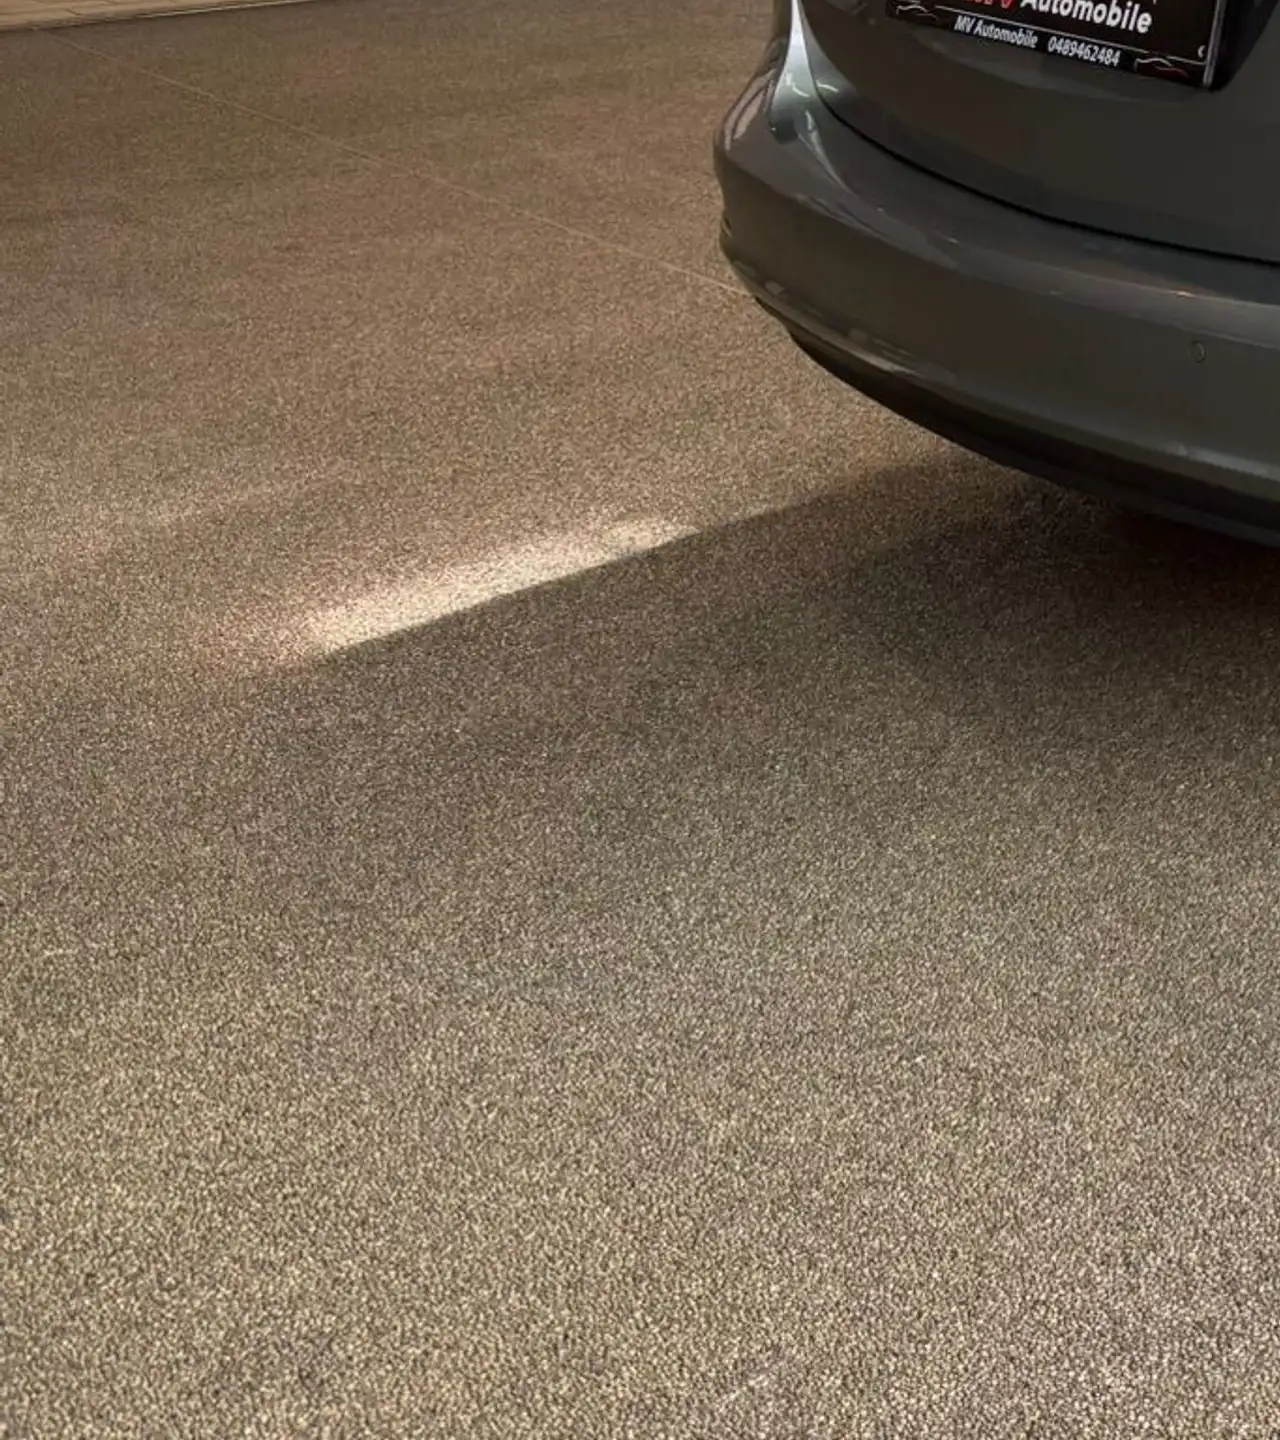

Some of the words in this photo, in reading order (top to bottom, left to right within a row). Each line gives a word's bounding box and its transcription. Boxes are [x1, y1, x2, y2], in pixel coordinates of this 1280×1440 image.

[955, 15, 974, 31] MV
[973, 20, 1039, 49] Automobile
[1047, 36, 1120, 67] 0489462484
